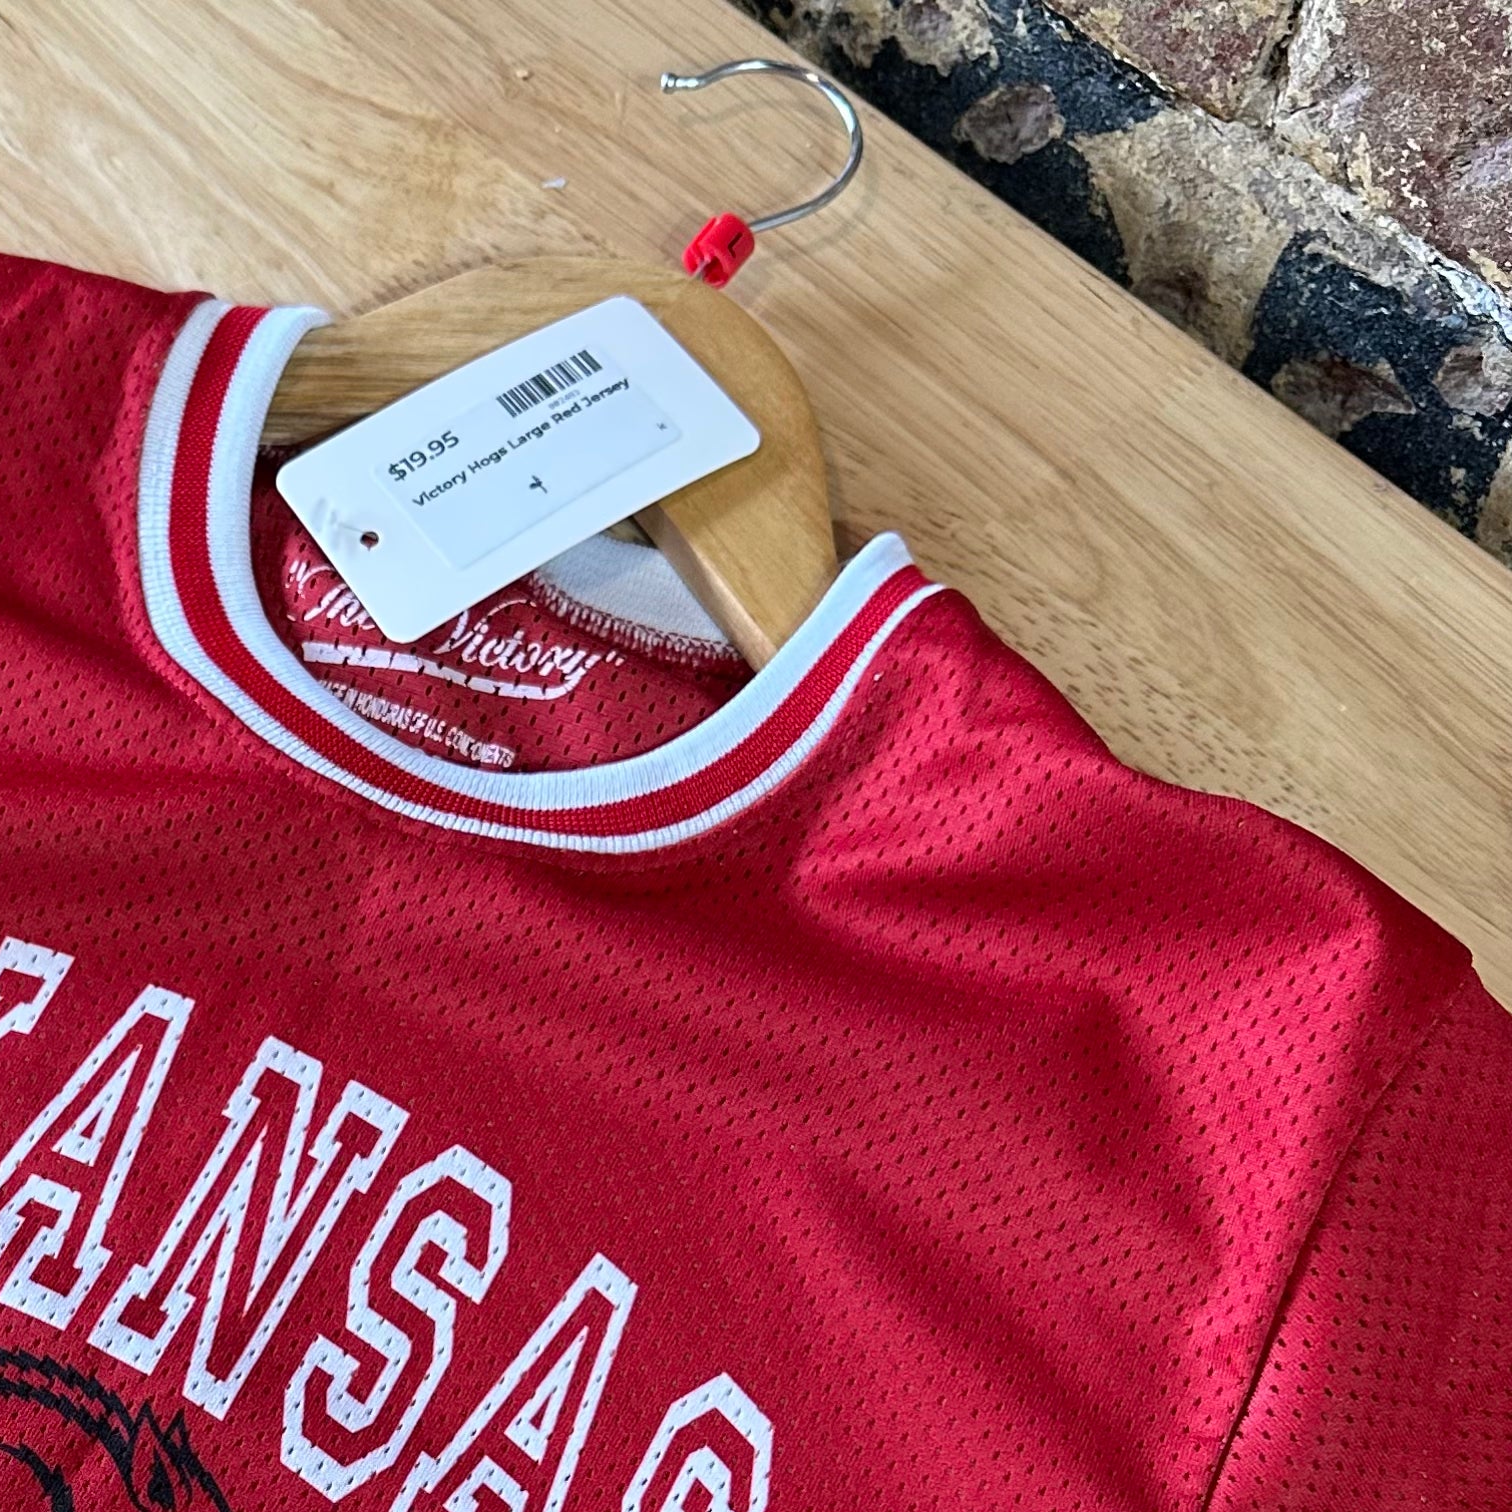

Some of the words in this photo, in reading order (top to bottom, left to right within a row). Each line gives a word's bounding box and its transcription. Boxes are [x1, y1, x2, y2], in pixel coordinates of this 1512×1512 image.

[388, 430, 460, 482] $19.95
[411, 470, 468, 508] Victory
[467, 446, 508, 475] Hogs
[507, 421, 552, 451] Large
[550, 402, 583, 425] Red
[580, 376, 631, 408] Jersey
